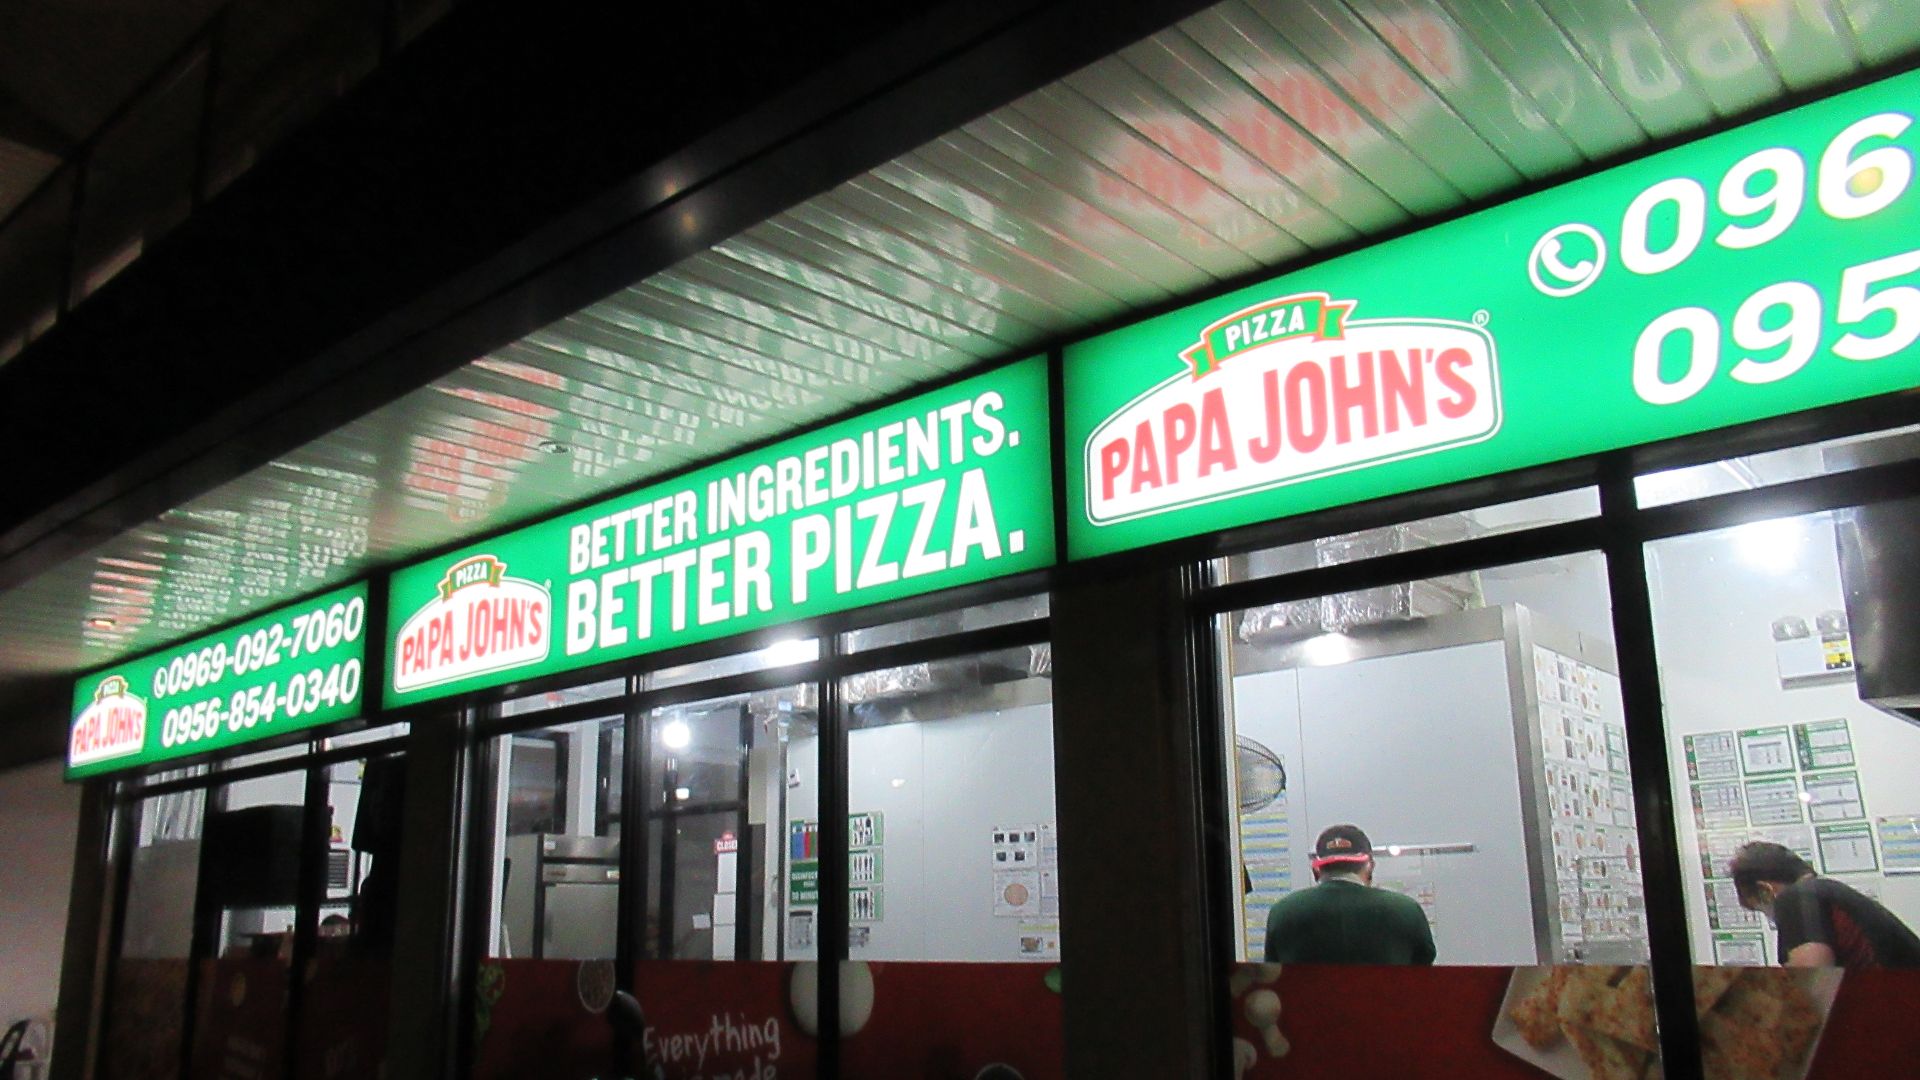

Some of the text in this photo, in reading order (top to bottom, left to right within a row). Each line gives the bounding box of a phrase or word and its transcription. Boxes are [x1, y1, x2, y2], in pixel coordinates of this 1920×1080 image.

[1620, 112, 1915, 275] 096
[1225, 305, 1305, 351] PIZZA
[1632, 250, 1920, 405] 095
[1101, 347, 1477, 501] PAPA JOHN'S
[569, 490, 698, 574] BETTER
[706, 391, 1020, 533] INGREDIENTS.
[455, 562, 487, 587] PIZZA
[565, 467, 1024, 656] BETTER PIZZA.
[167, 596, 364, 695] 0969-092-7060
[402, 598, 543, 676] PAPA JOHN'S
[74, 712, 101, 756] PAPA
[162, 659, 360, 748] 0956-854-0340
[643, 1012, 781, 1071] Everything
